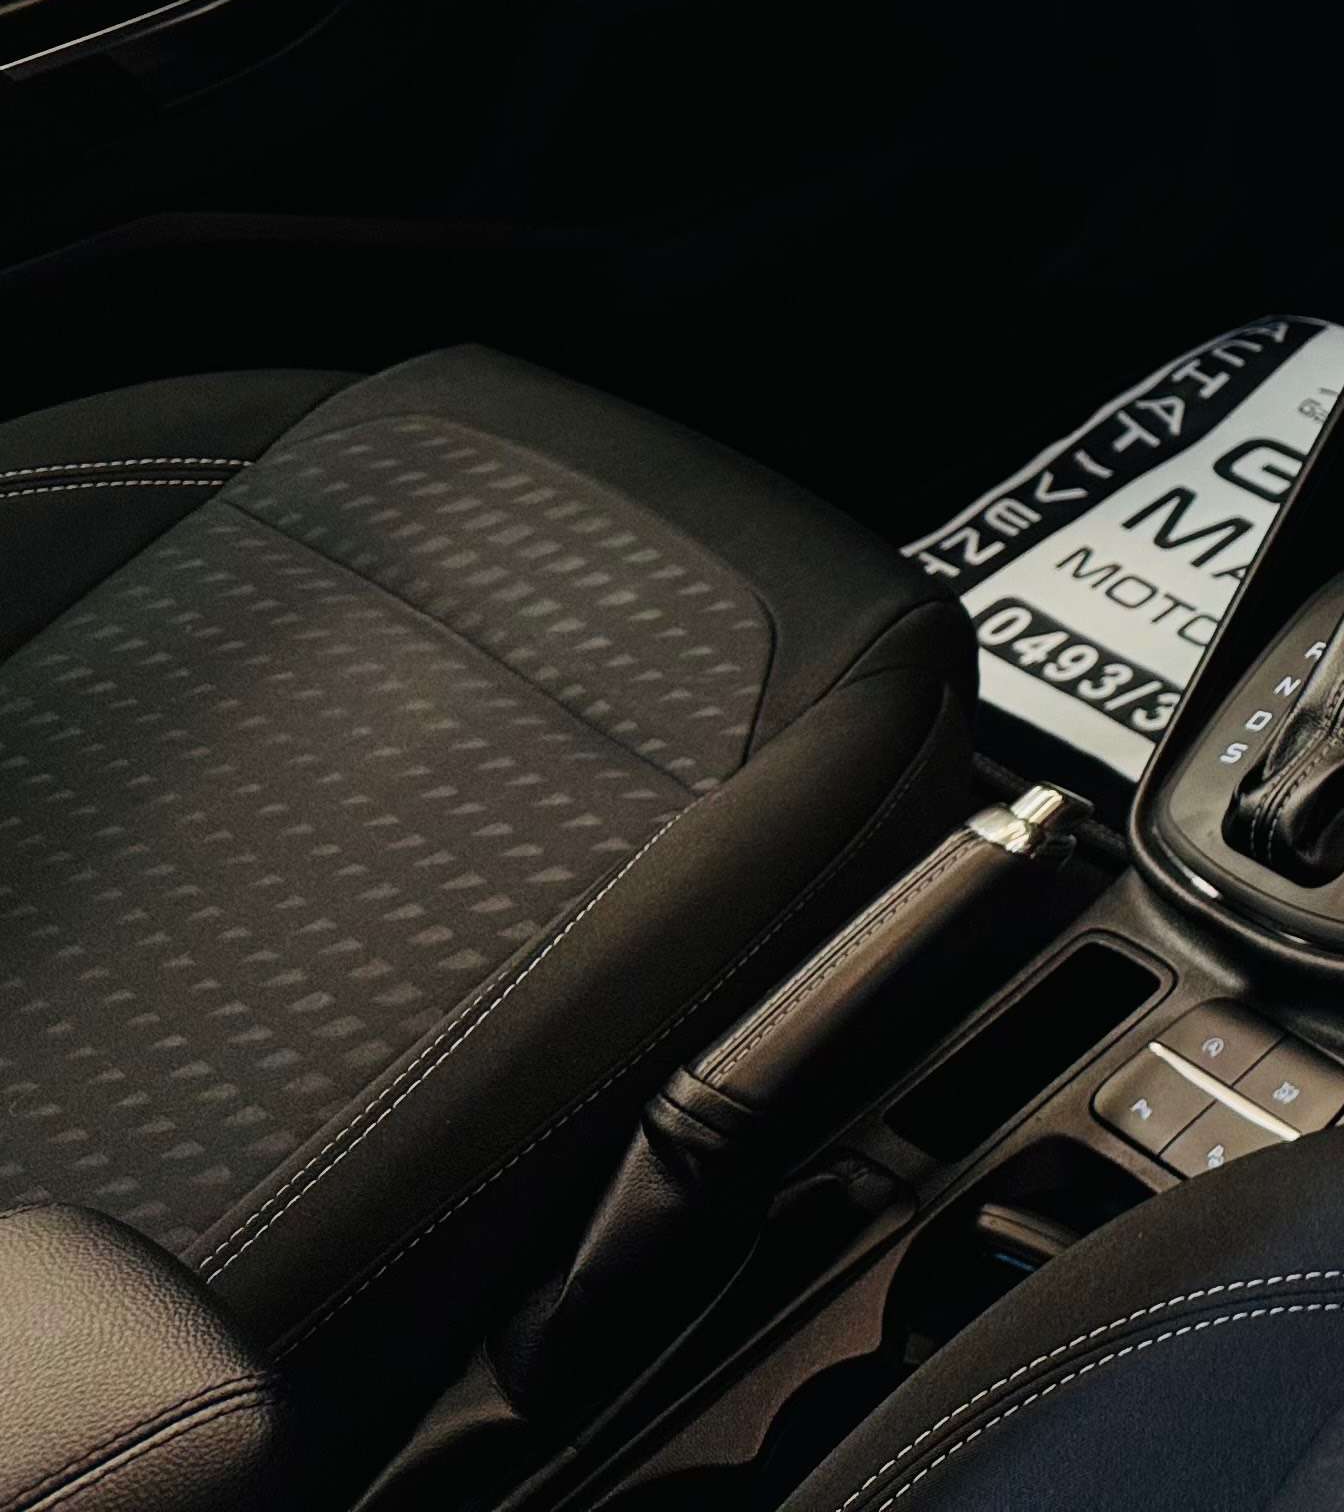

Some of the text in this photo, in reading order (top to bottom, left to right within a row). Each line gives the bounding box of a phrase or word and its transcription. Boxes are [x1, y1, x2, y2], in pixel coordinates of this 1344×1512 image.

[1056, 545, 1220, 646] MOTO
[1274, 676, 1300, 696] N
[1245, 710, 1272, 730] D
[1220, 743, 1248, 764] S
